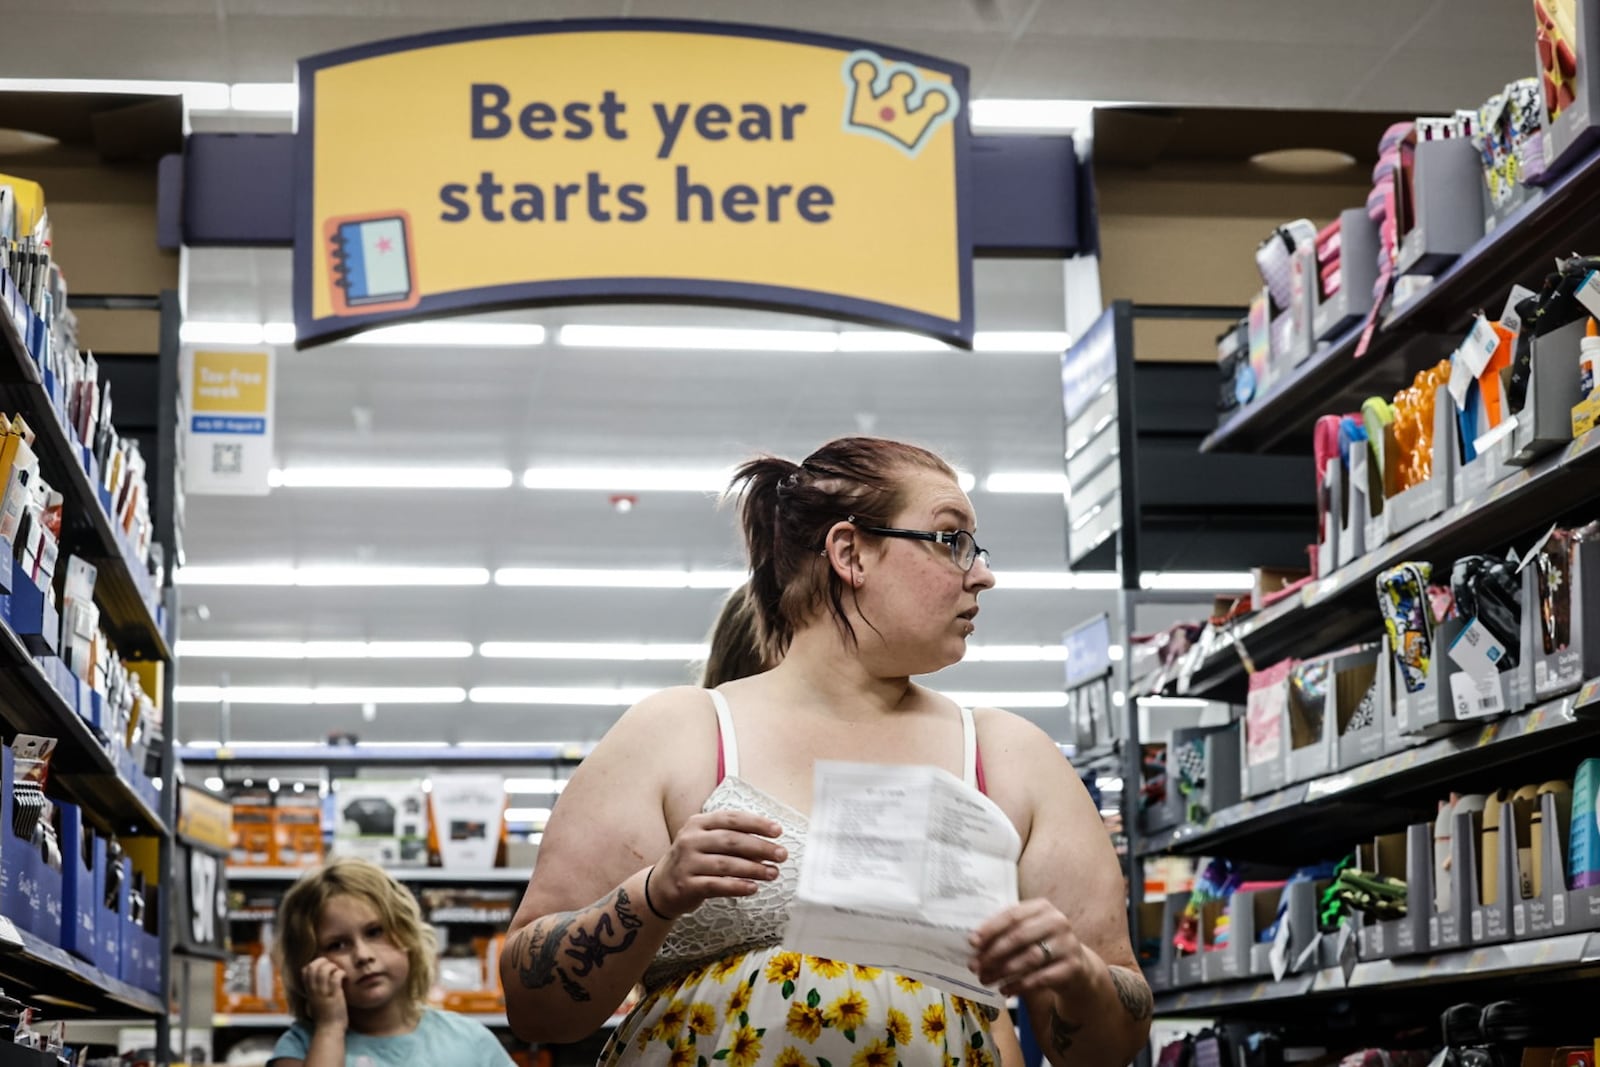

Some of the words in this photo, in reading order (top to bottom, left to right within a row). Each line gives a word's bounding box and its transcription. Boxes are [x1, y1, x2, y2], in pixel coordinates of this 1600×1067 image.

[469, 83, 628, 141] Best
[653, 101, 808, 158] year
[438, 171, 649, 223] starts
[675, 165, 835, 223] here
